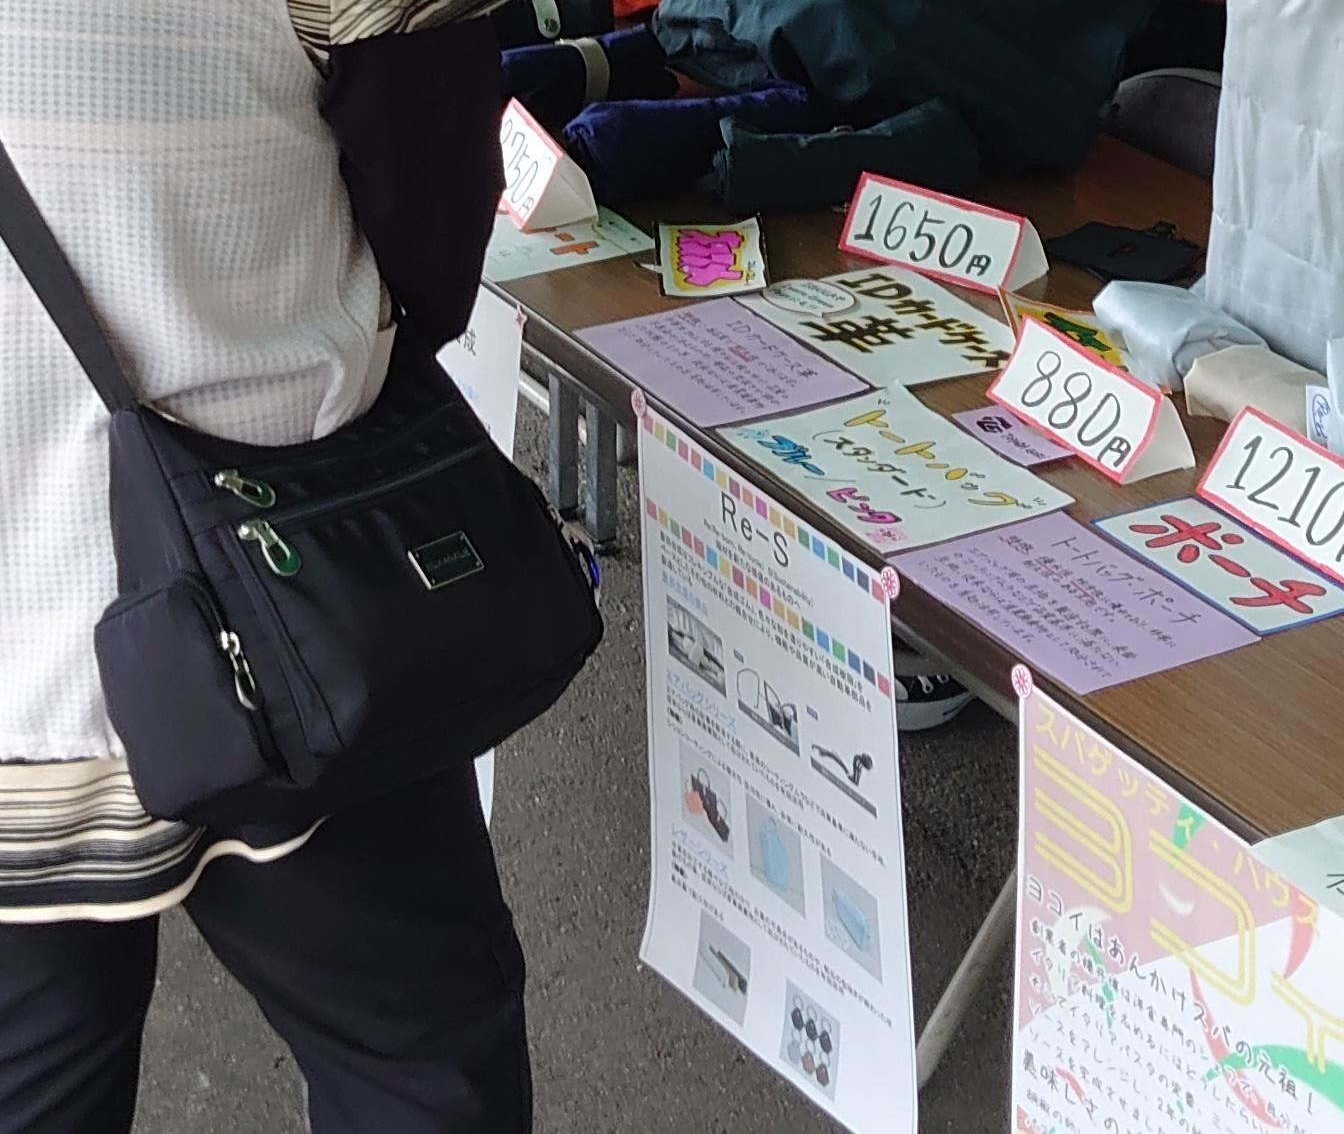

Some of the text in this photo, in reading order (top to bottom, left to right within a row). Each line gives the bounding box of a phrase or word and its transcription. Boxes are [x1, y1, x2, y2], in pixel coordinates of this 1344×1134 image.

[853, 193, 993, 277] 1650円
[844, 409, 1033, 510] トートバッグ
[1021, 350, 1132, 468] 880円
[720, 490, 791, 570] Re-S
[1129, 514, 1328, 615] ポーチ
[1033, 702, 1320, 938] スパゲッティ・ハウス
